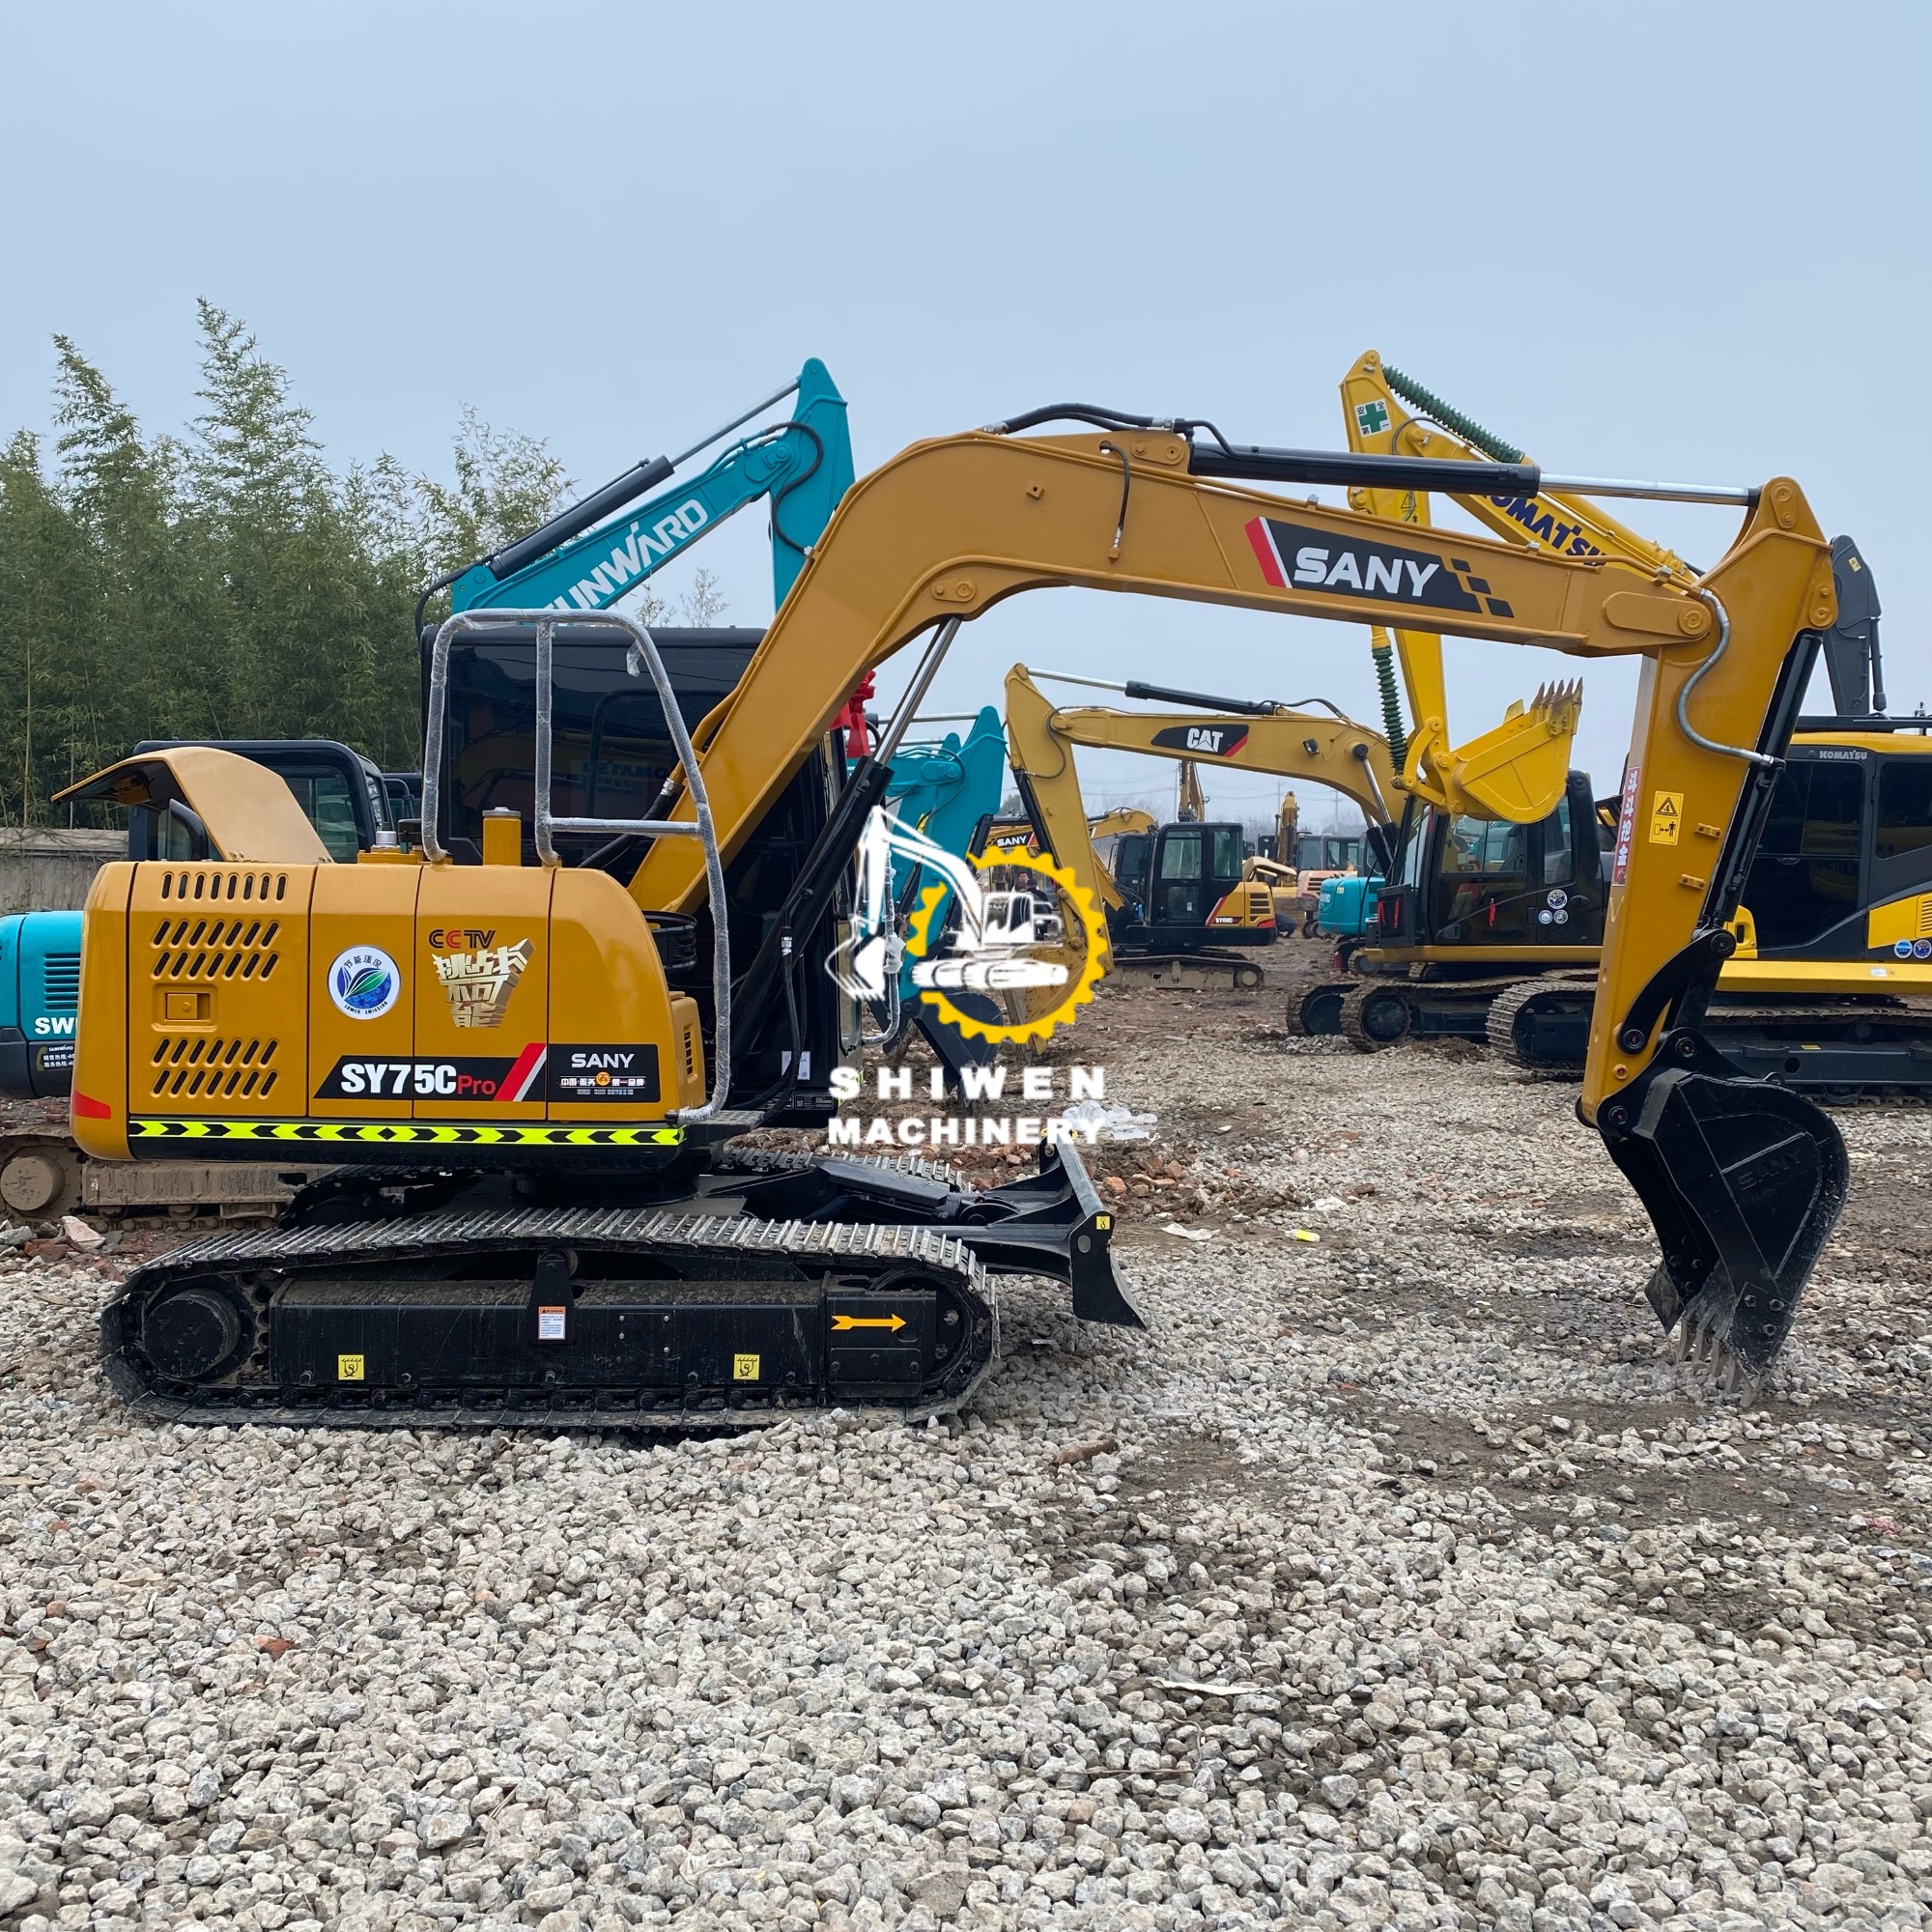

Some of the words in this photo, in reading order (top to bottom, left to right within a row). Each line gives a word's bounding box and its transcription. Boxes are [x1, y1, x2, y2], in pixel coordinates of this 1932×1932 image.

[1482, 495, 1607, 566] OMATS
[543, 499, 708, 610] UNWARD
[1293, 547, 1440, 597] SANY
[1186, 727, 1224, 753] CAT
[1819, 750, 1868, 760] KOMATSU
[997, 836, 1027, 847] SANY
[429, 929, 497, 949] CCTV
[35, 1017, 77, 1035] SW
[571, 1053, 635, 1068] SANY
